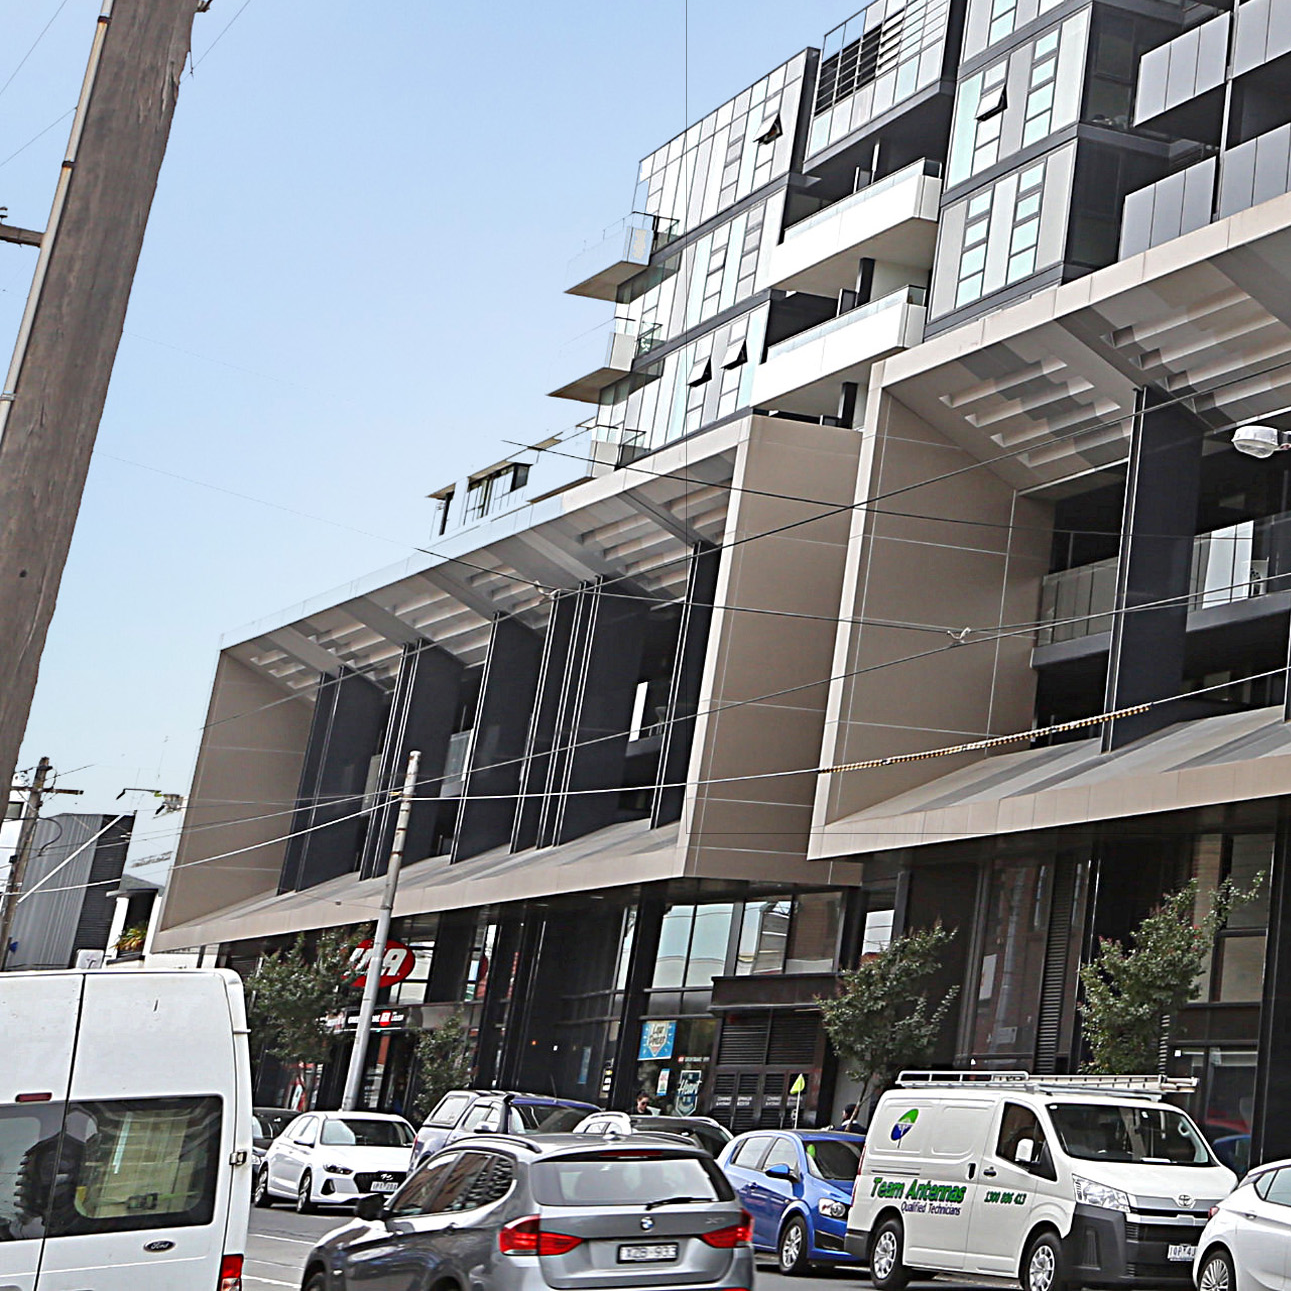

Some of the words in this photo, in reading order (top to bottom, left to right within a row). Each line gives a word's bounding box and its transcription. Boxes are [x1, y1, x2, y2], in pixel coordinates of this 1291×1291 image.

[871, 1177, 904, 1199] Team
[906, 1178, 967, 1203] Antennas
[900, 1201, 926, 1214] Qualified
[928, 1203, 961, 1216] Technicians
